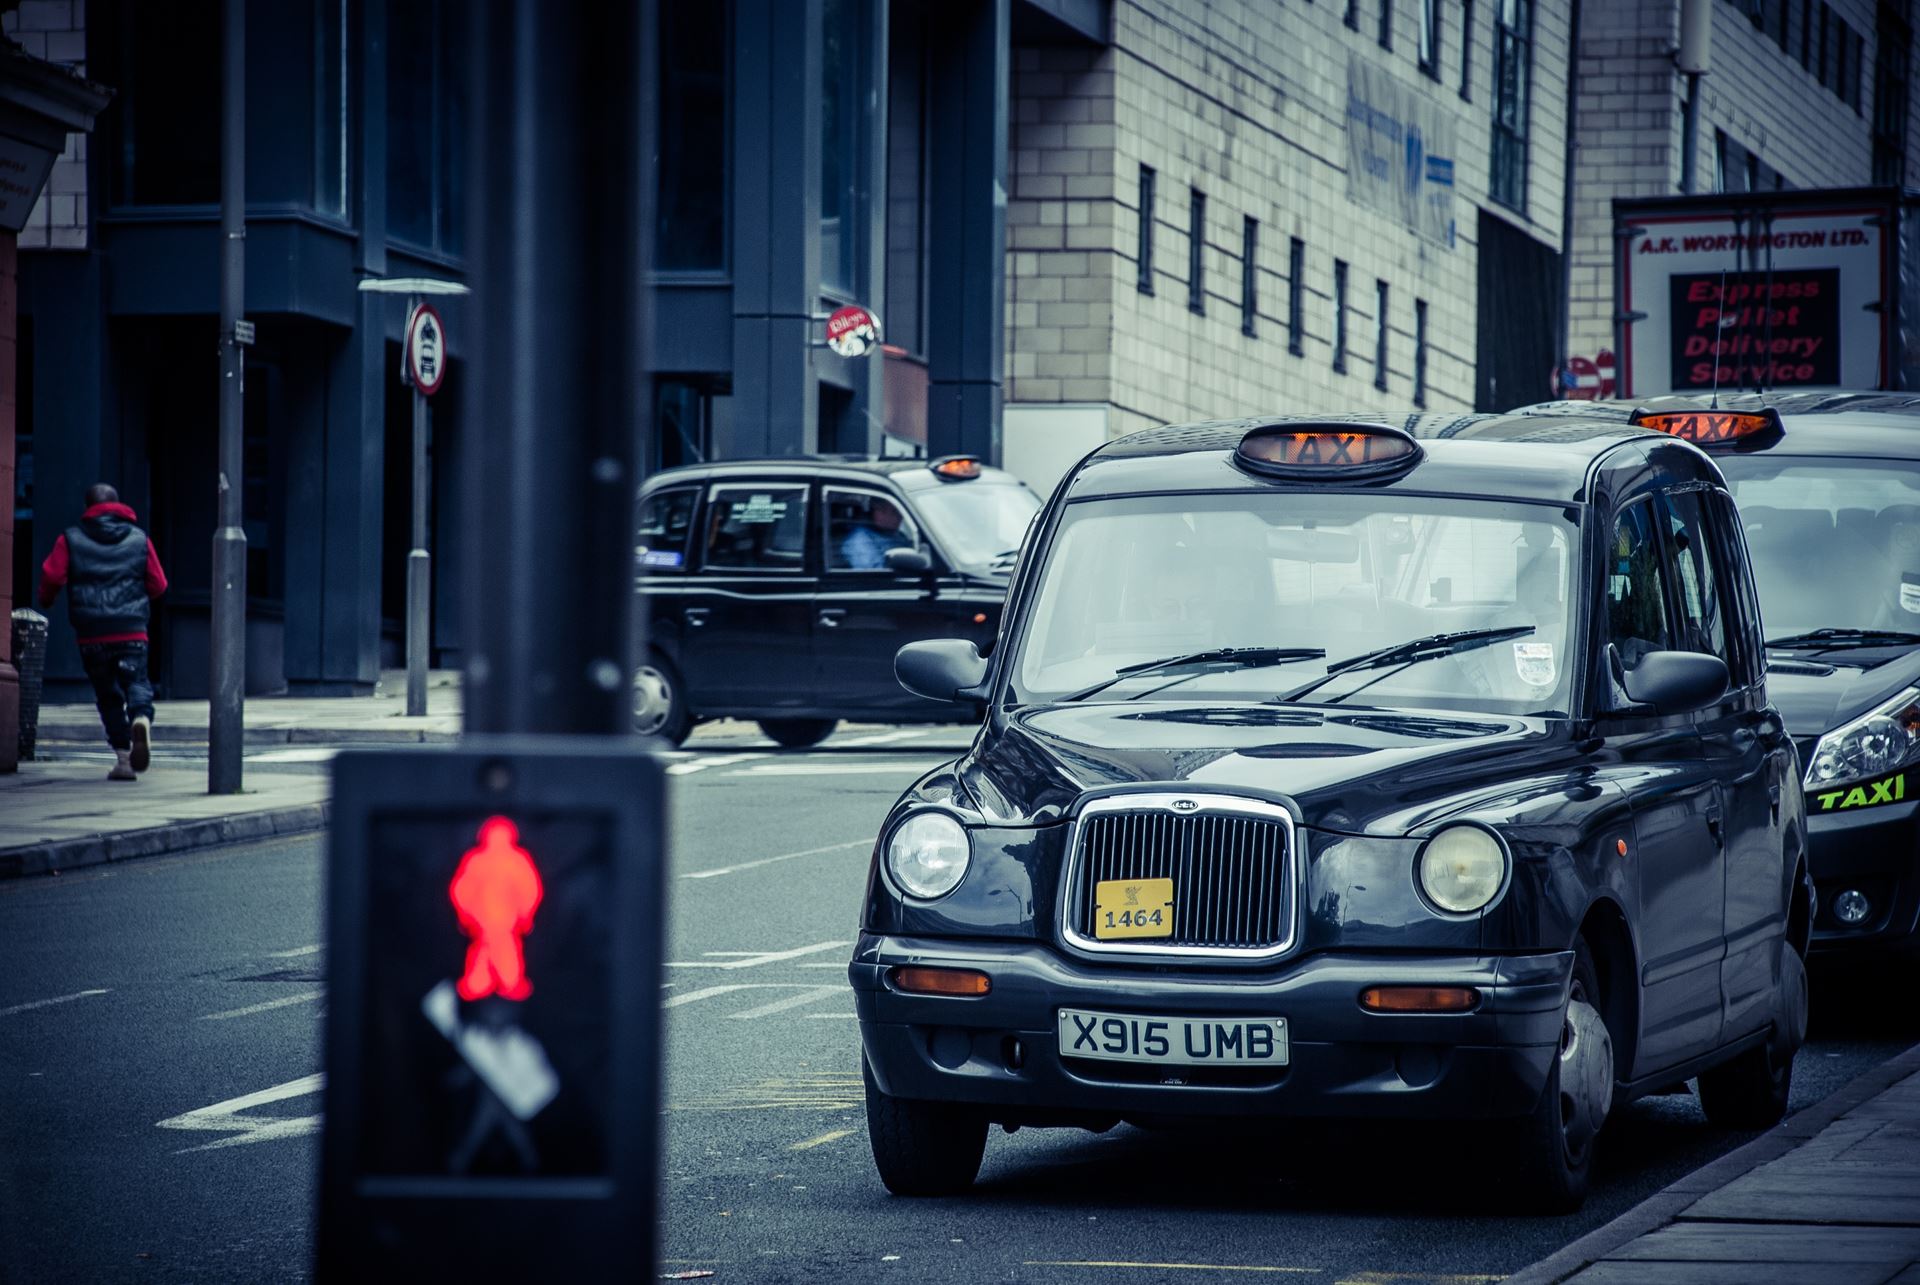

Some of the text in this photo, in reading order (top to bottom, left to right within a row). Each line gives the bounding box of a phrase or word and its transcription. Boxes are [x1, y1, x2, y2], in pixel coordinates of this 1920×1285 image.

[1639, 238, 1679, 255] A.K.
[1830, 228, 1870, 247] LTD.
[1686, 280, 1819, 305] Express
[1684, 335, 1823, 358] Delivery
[1689, 361, 1816, 384] Service
[1662, 415, 1739, 443] TAXI
[1274, 435, 1374, 464] TAXI
[1817, 773, 1905, 810] TAXI
[1105, 908, 1163, 929] 1464
[1072, 1014, 1274, 1059] X915 UMB
